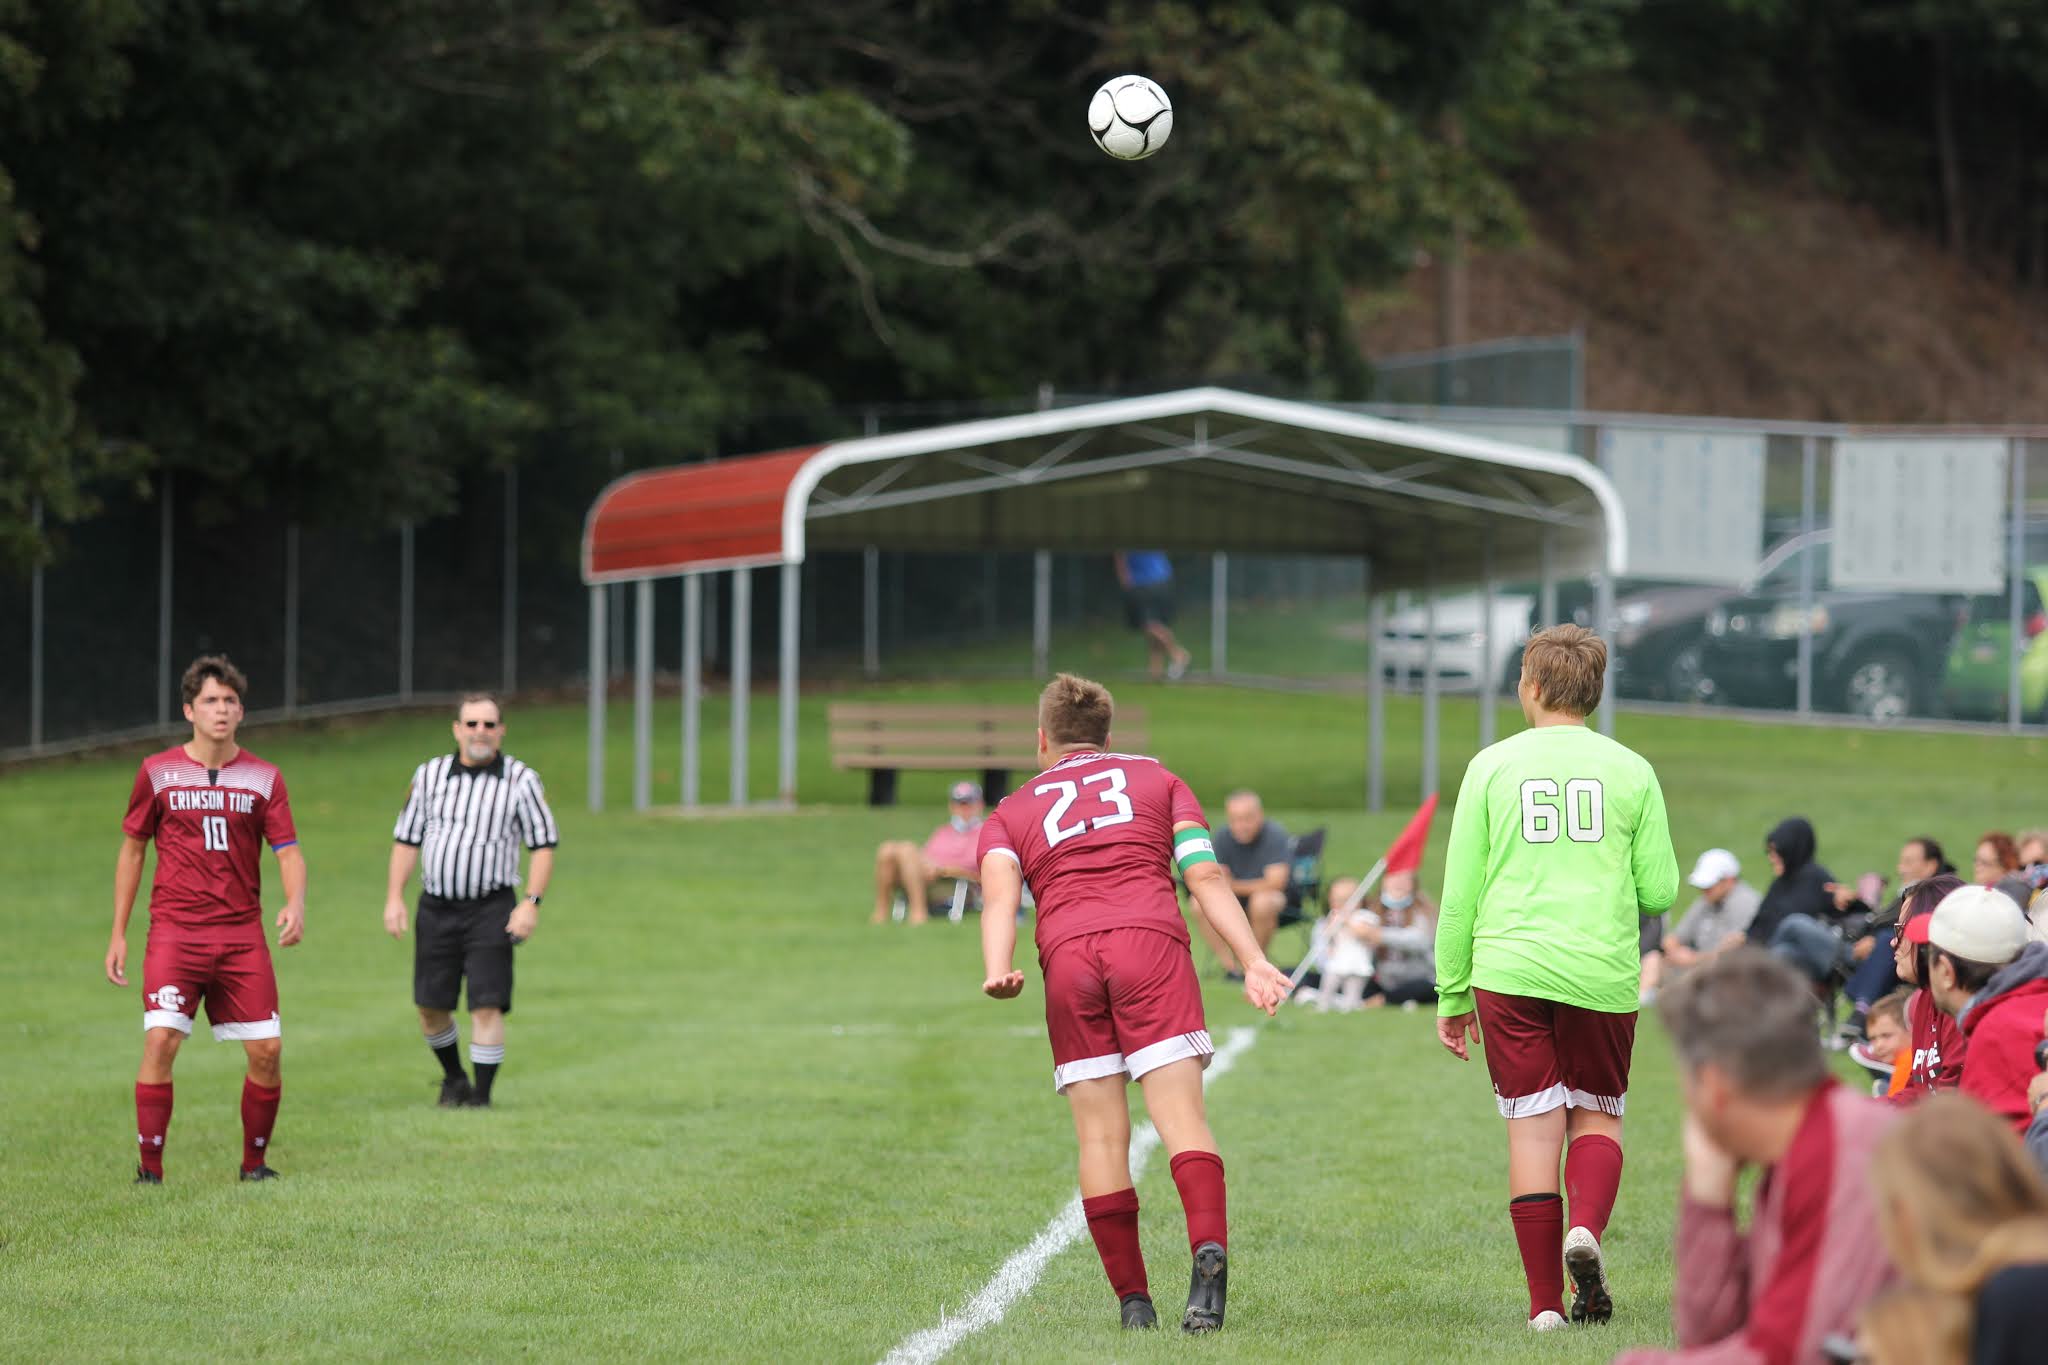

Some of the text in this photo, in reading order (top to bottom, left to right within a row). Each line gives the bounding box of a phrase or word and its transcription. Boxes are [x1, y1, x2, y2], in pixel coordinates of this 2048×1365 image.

[169, 790, 256, 814] CRIMSON TIDE
[1034, 767, 1134, 848] 23
[1520, 778, 1604, 843] 60
[202, 815, 229, 852] 10
